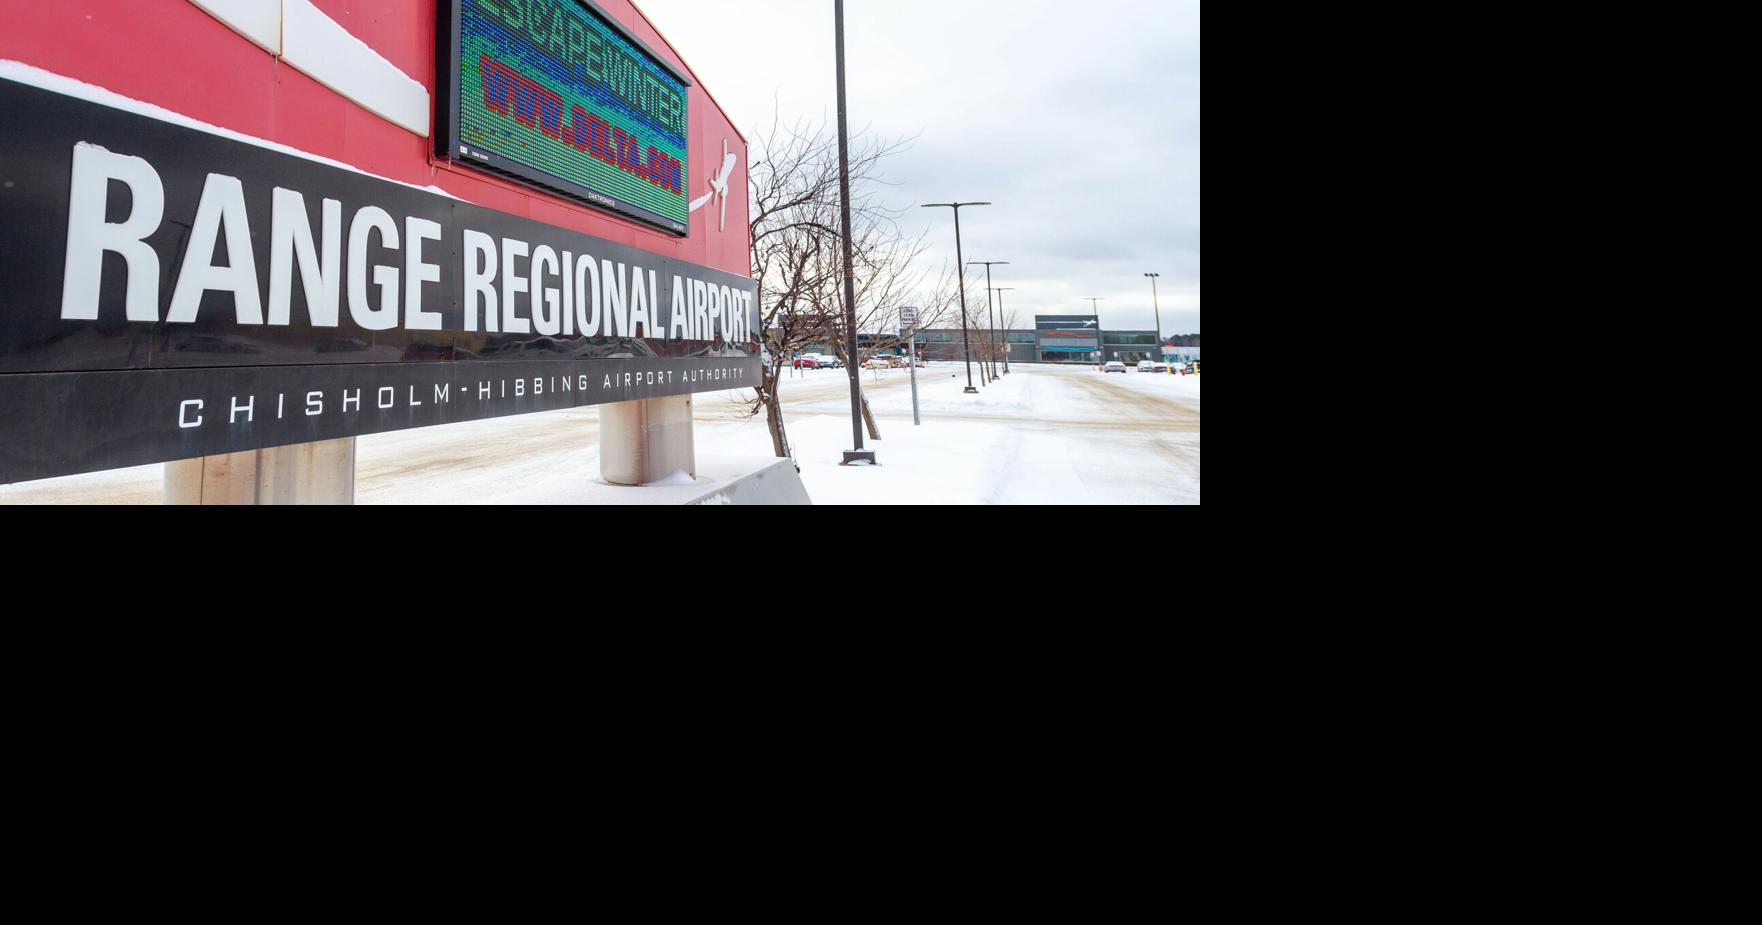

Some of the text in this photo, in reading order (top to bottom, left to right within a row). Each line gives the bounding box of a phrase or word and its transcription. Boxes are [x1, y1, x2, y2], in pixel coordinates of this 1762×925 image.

[477, 0, 601, 82] SCAPE
[60, 140, 752, 343] RANGE REGIONAL AIRPORT
[178, 367, 744, 429] CHISHOLM-HIBBING AIRPORT AUTHORITY
